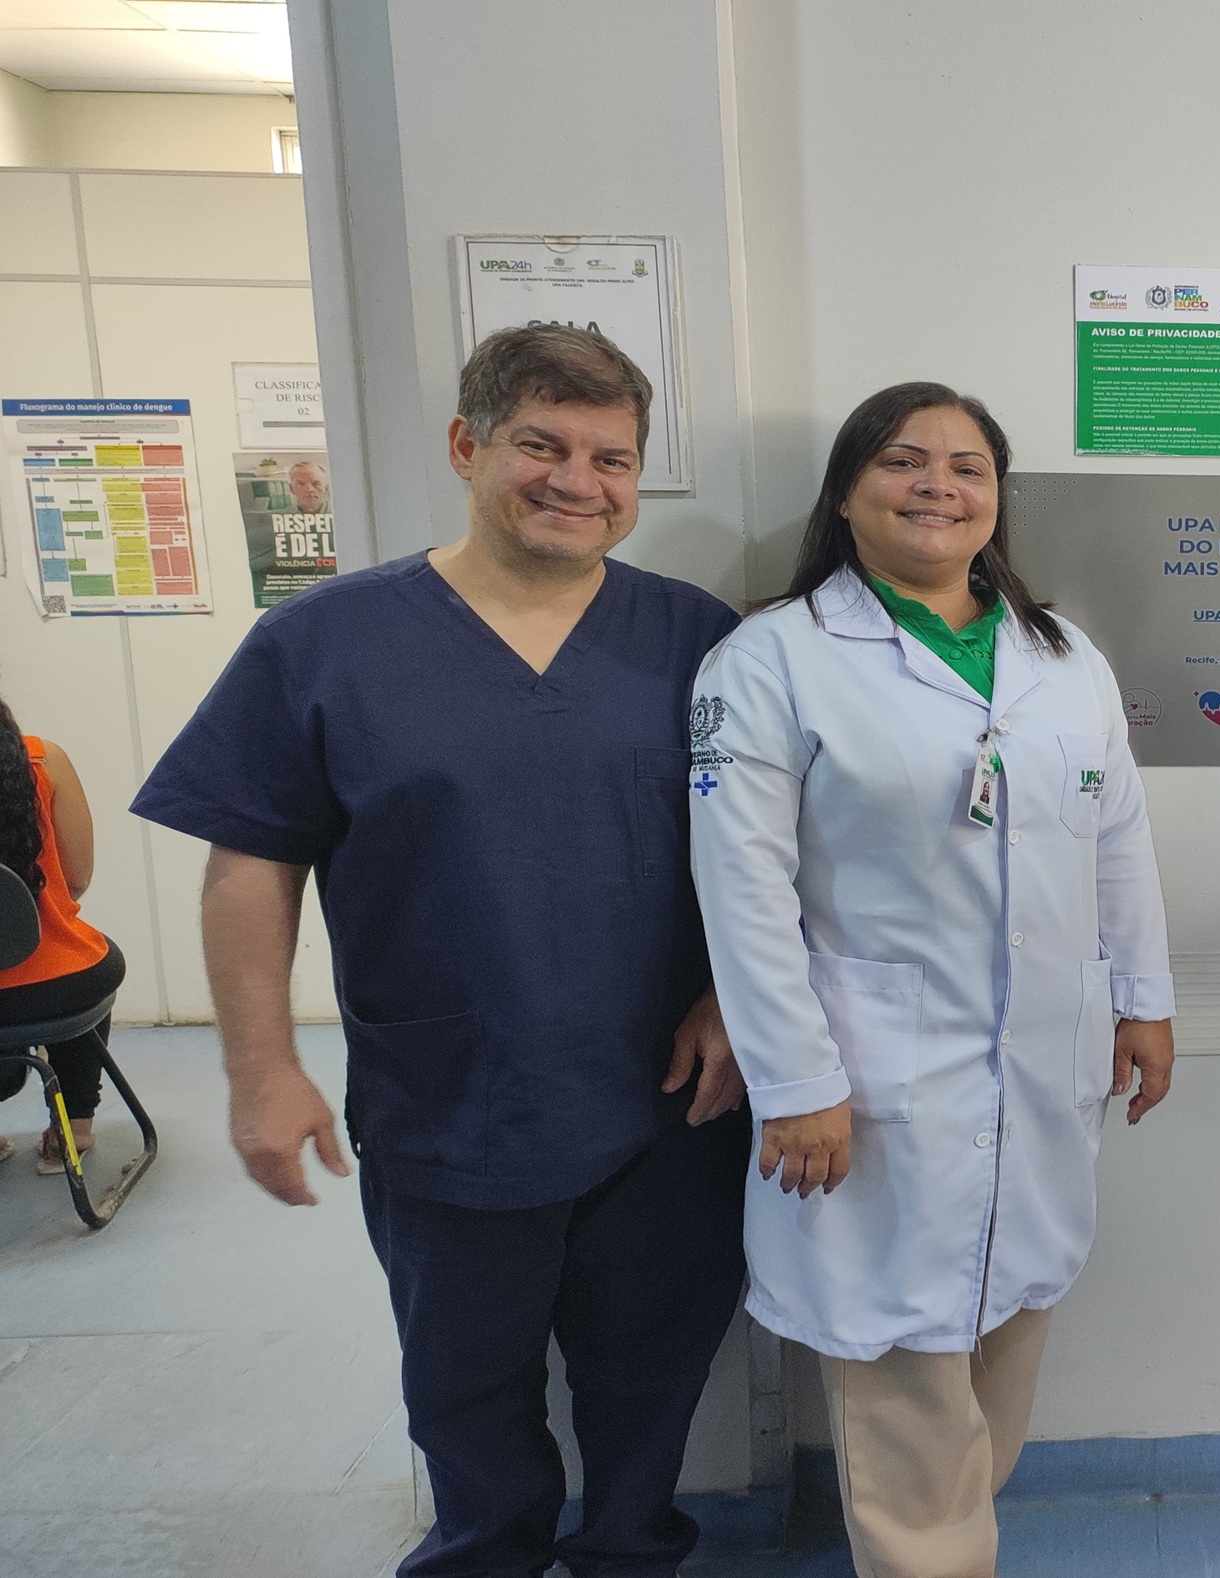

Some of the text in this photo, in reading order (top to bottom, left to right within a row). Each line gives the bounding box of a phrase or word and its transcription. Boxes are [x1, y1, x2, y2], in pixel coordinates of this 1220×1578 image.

[480, 260, 532, 270] UPA24h
[1091, 328, 1126, 337] AVISO
[1129, 329, 1144, 337] DE
[255, 381, 321, 390] CLASSIFICA
[276, 394, 320, 402] DE RISC
[19, 403, 64, 412] Fluxograma
[65, 403, 75, 411] do
[77, 403, 105, 412] manejo
[133, 403, 143, 411] de
[144, 403, 172, 412] dengue
[297, 407, 310, 416] 02
[1168, 517, 1215, 532] UPA
[275, 533, 336, 558] É DE L
[1179, 540, 1212, 554] DO
[276, 559, 316, 567] VIOLÊNCIA
[1164, 561, 1219, 576] MAIS
[1185, 656, 1218, 665] Recife,
[692, 756, 734, 765] AMBUCO
[1081, 770, 1105, 785] UPA2
